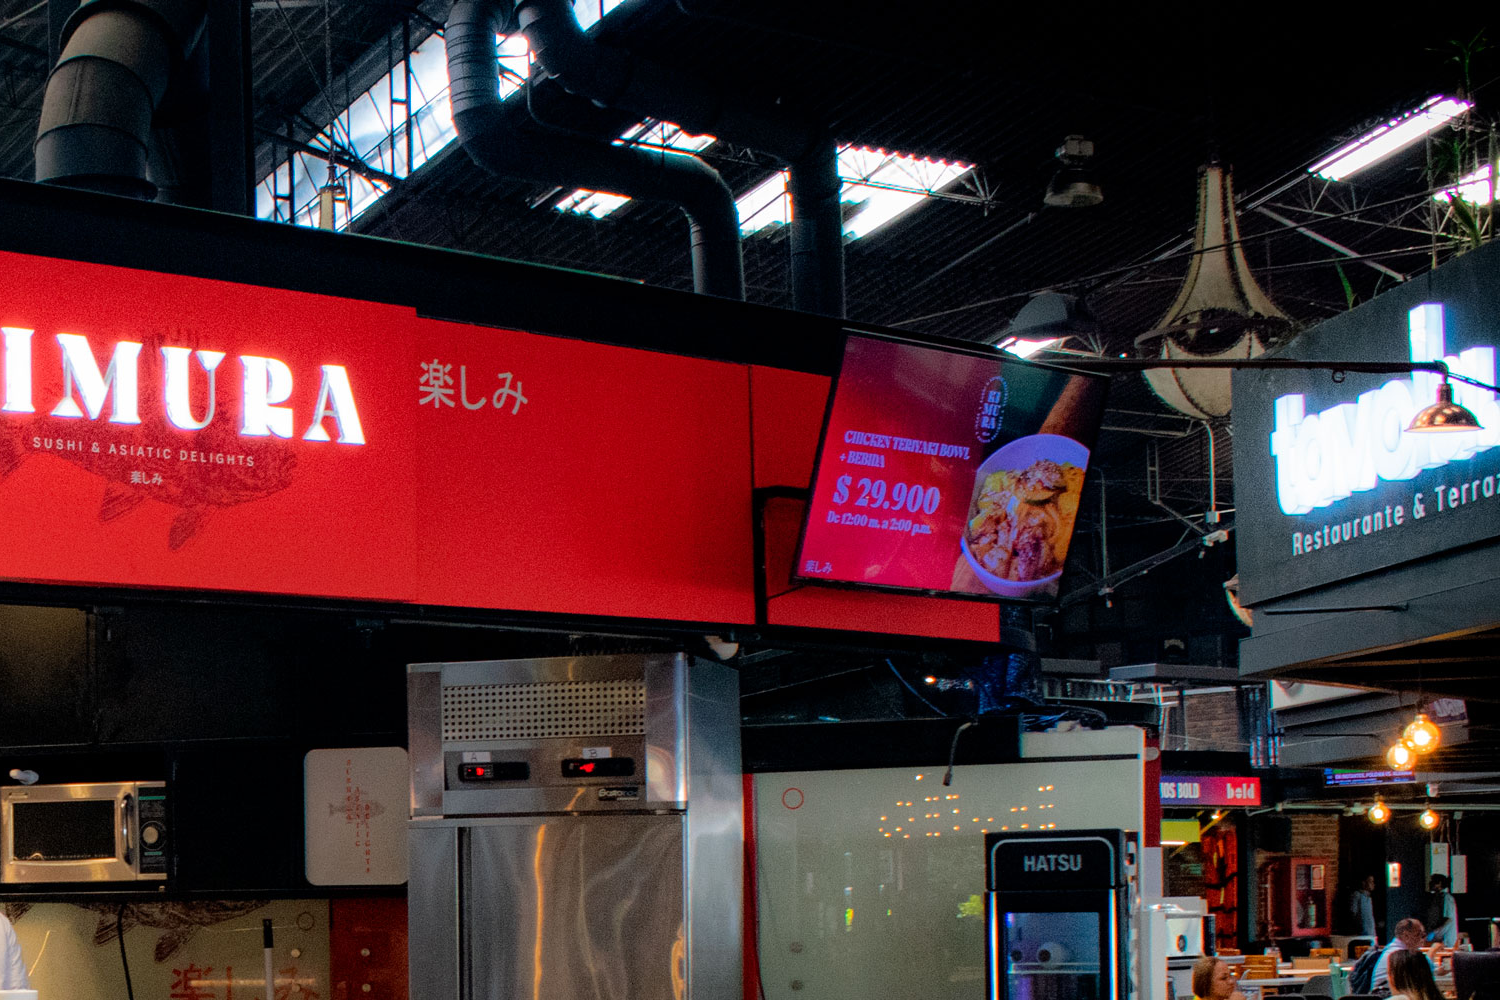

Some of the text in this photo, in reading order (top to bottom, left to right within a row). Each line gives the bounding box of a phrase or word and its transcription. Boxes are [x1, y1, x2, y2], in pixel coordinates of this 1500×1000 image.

[418, 358, 529, 416] 楽しみ
[32, 437, 255, 467] SUSHI & ASIATIC DELIGHTS
[844, 429, 971, 461] CHICKEN TERIYAKI BOWL
[846, 450, 885, 469] BEBIDA
[855, 477, 941, 515] 29.900
[841, 512, 868, 527] 12:00
[889, 517, 912, 532] 2:00
[1292, 503, 1404, 557] Restaurante
[1412, 492, 1426, 520] &
[1177, 782, 1200, 799] BOLD
[1226, 782, 1255, 800] bold
[1023, 854, 1083, 872] HATSU
